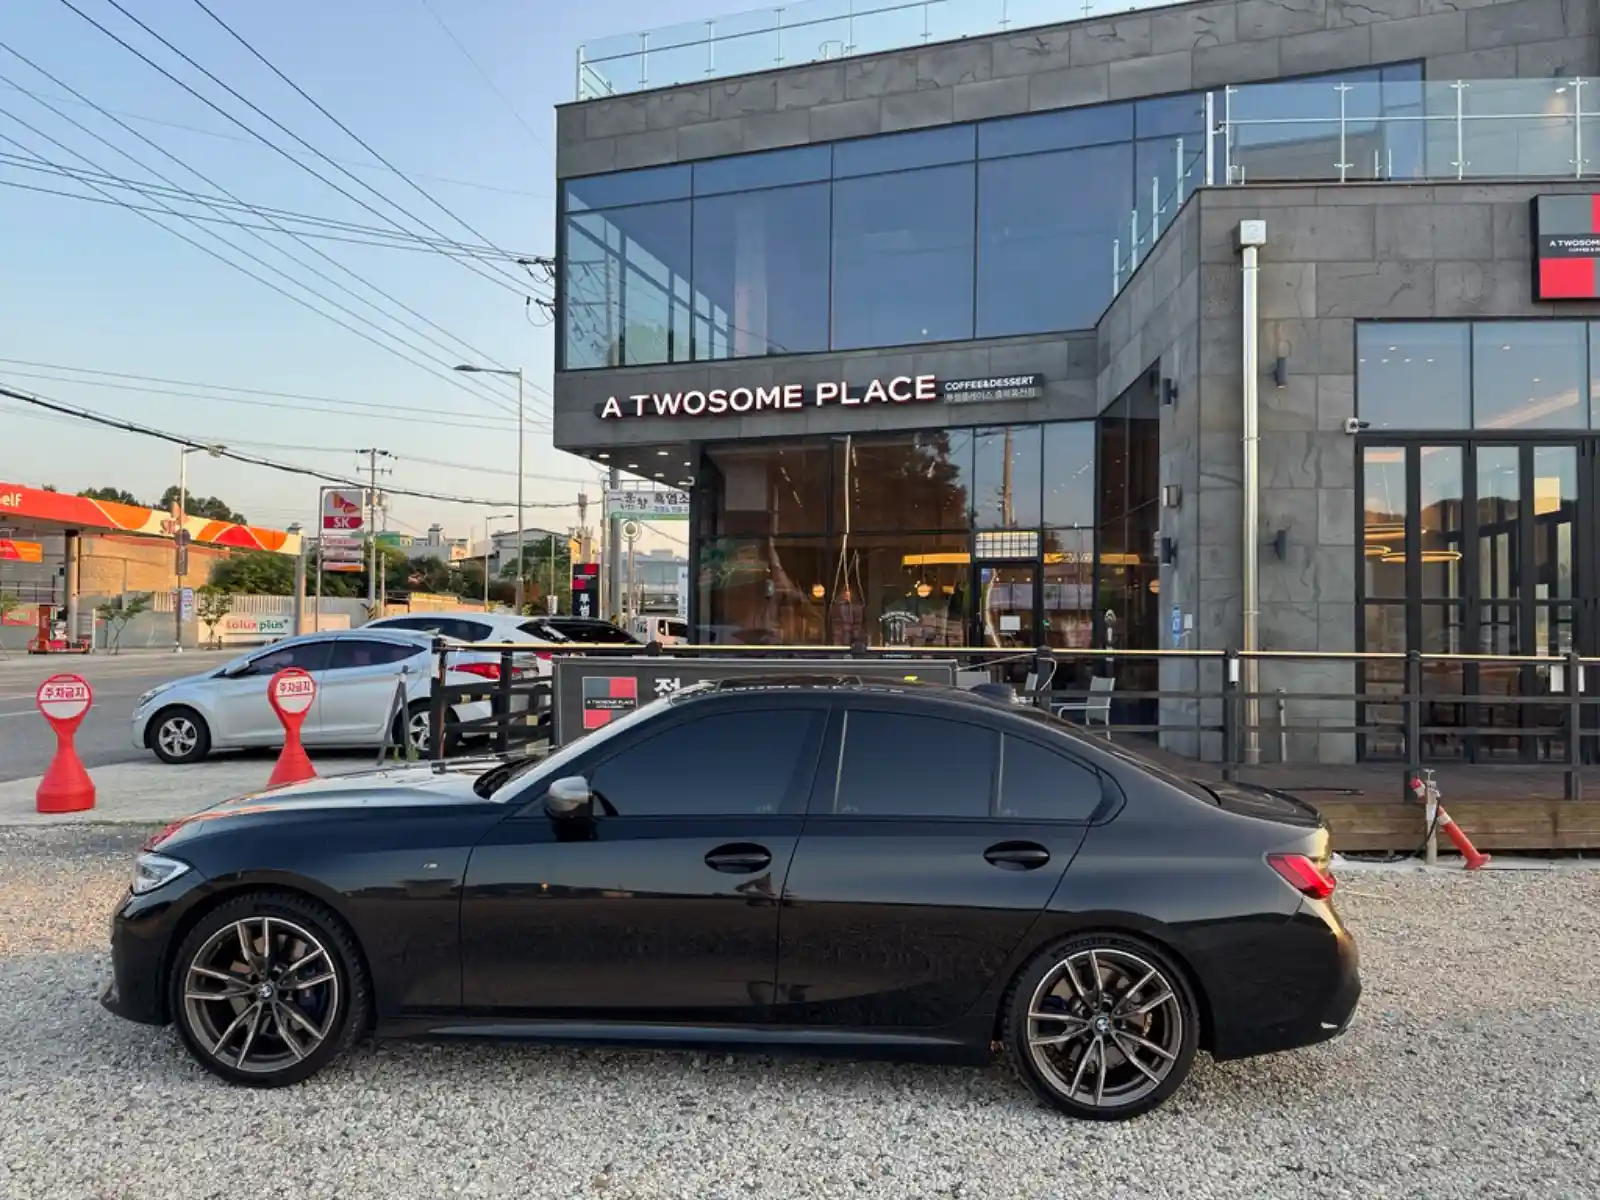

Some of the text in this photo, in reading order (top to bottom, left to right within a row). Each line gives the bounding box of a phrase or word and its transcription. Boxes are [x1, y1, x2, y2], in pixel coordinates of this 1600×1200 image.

[601, 374, 937, 418] A TWOSOME PLACE
[333, 517, 350, 528] SK
[44, 687, 85, 699] 주차금지
